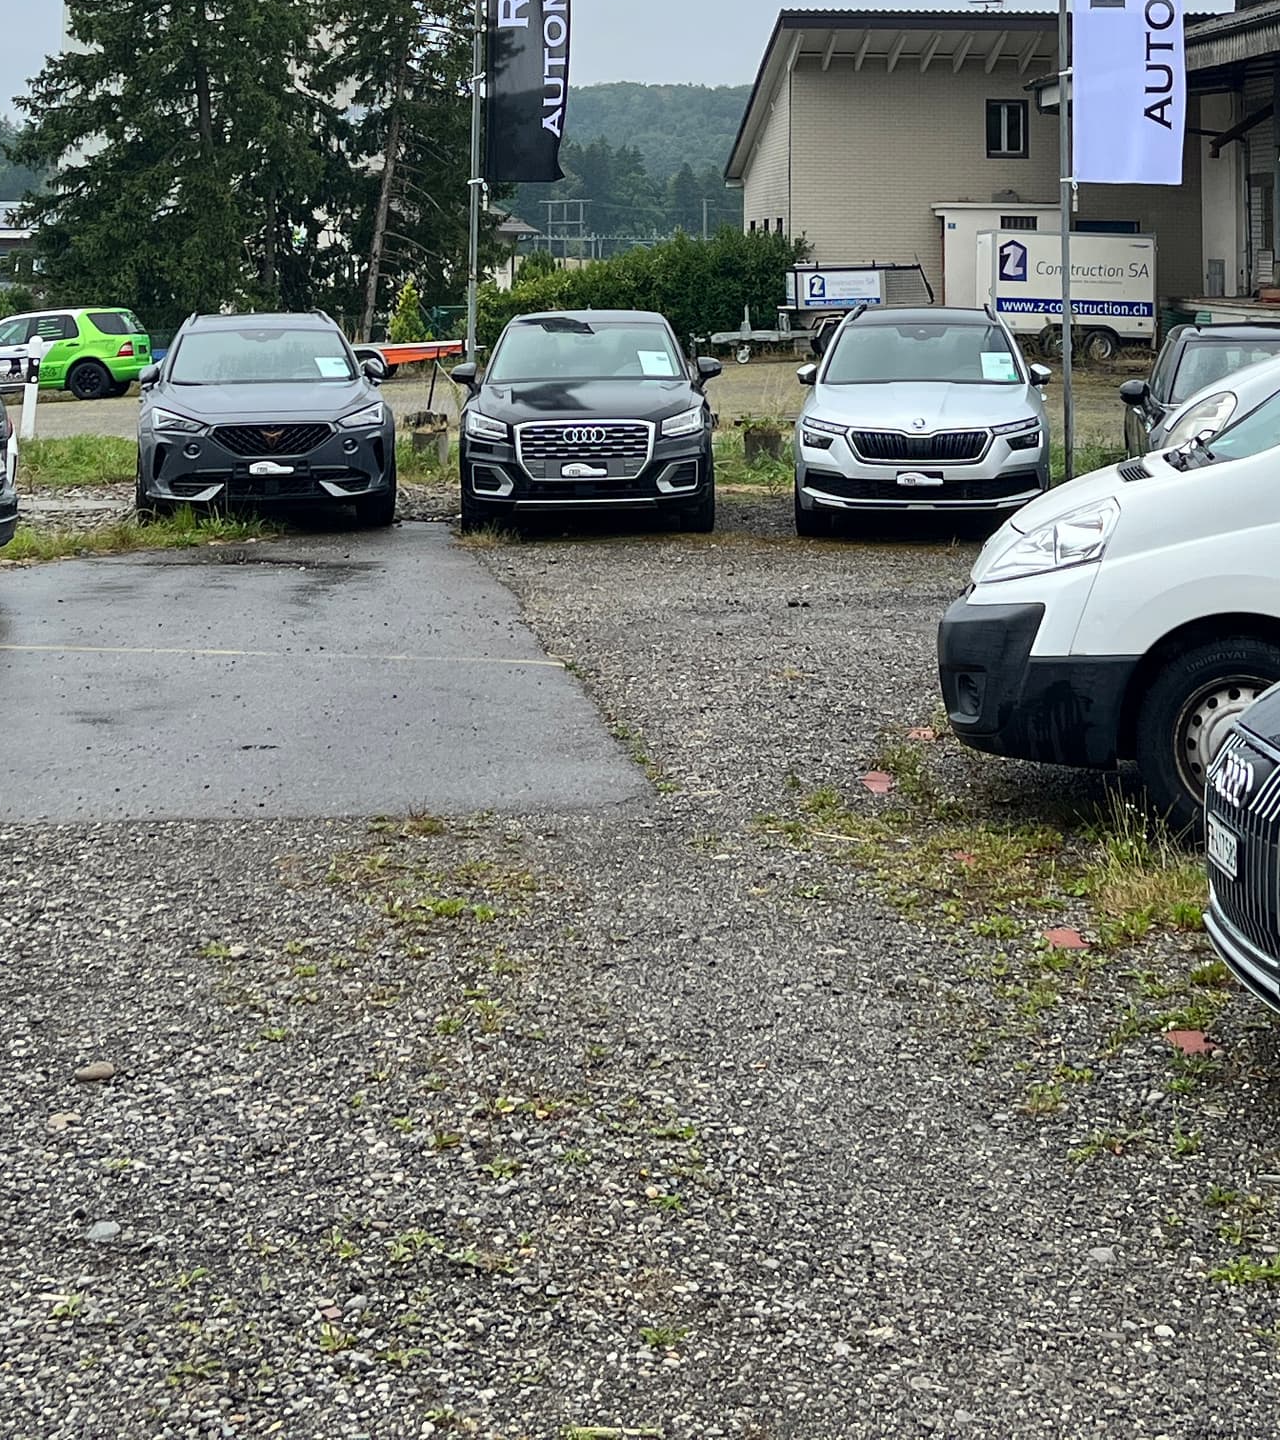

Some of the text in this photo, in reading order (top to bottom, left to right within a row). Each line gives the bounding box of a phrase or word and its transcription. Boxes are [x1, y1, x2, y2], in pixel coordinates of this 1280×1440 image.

[1035, 260, 1124, 278] Contruction
[1128, 262, 1150, 279] SA
[1001, 300, 1148, 316] www.z-costruction.ch
